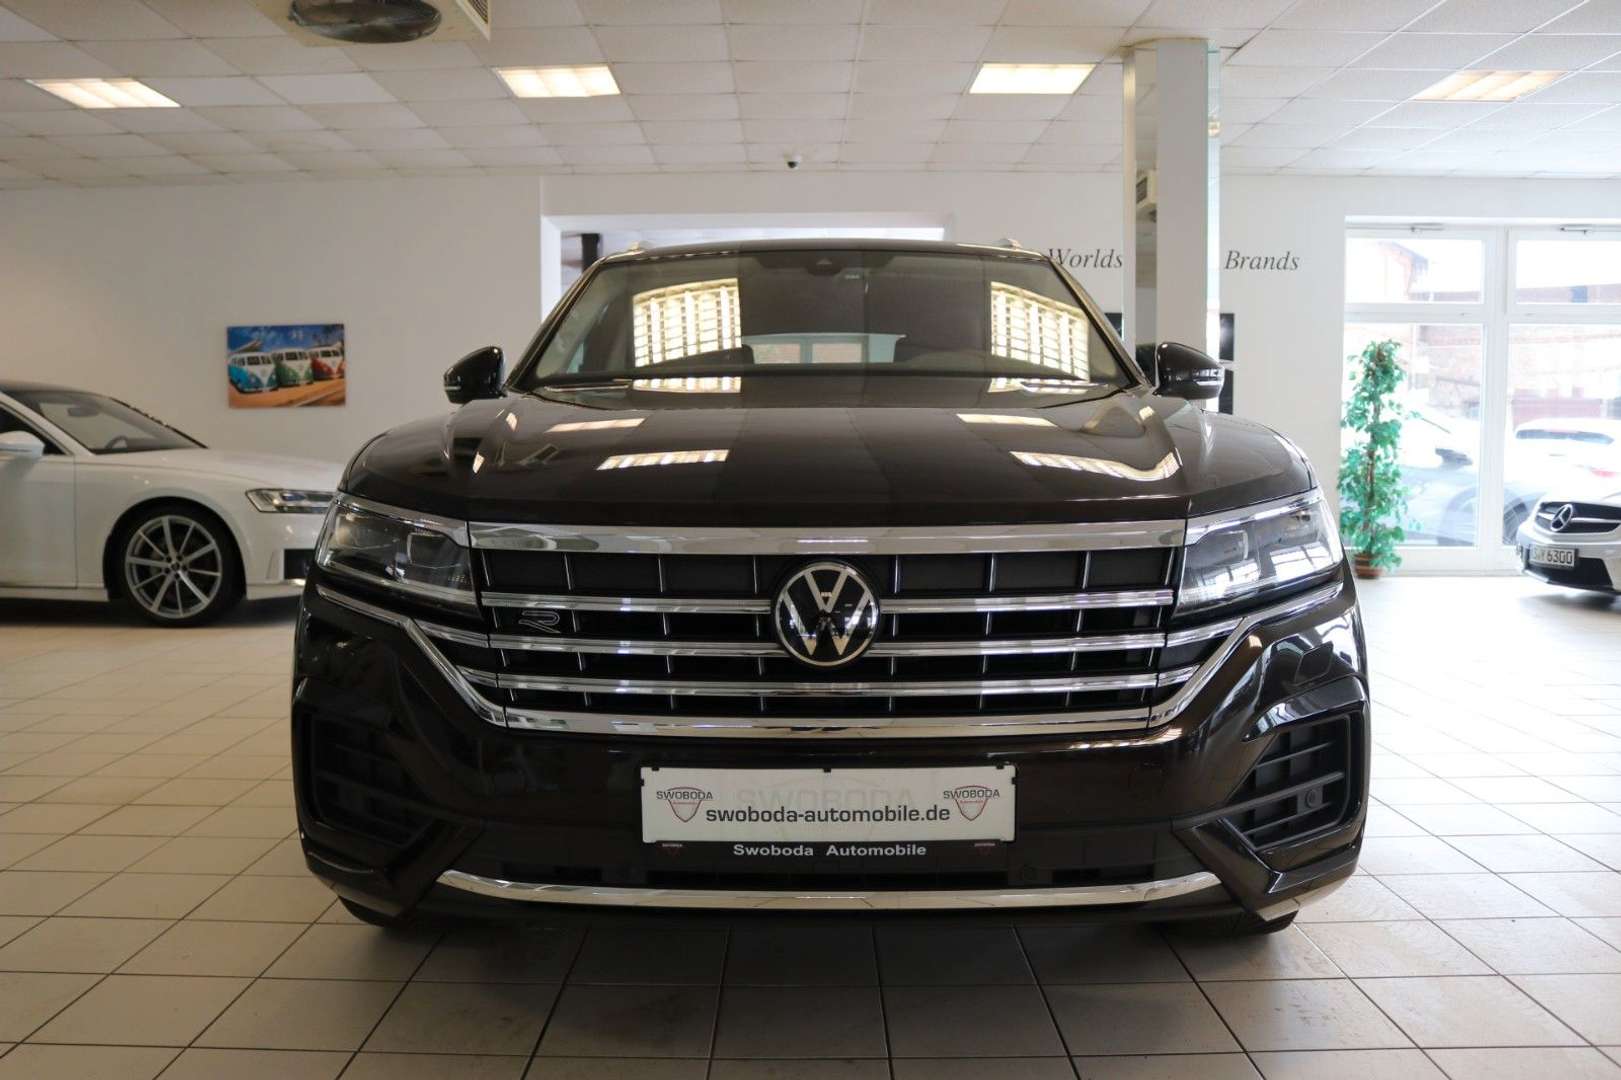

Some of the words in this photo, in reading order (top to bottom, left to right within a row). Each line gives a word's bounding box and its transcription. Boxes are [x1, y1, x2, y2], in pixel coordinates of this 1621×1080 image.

[1048, 248, 1123, 268] Worlds
[1224, 250, 1299, 271] Brands
[1547, 550, 1573, 564] 6300
[656, 790, 713, 800] SWOBODA
[943, 788, 1000, 800] SWOBODA
[706, 805, 951, 823] swoboda-automobile.de
[733, 844, 814, 857] Swoboda
[826, 844, 927, 857] Automobile
